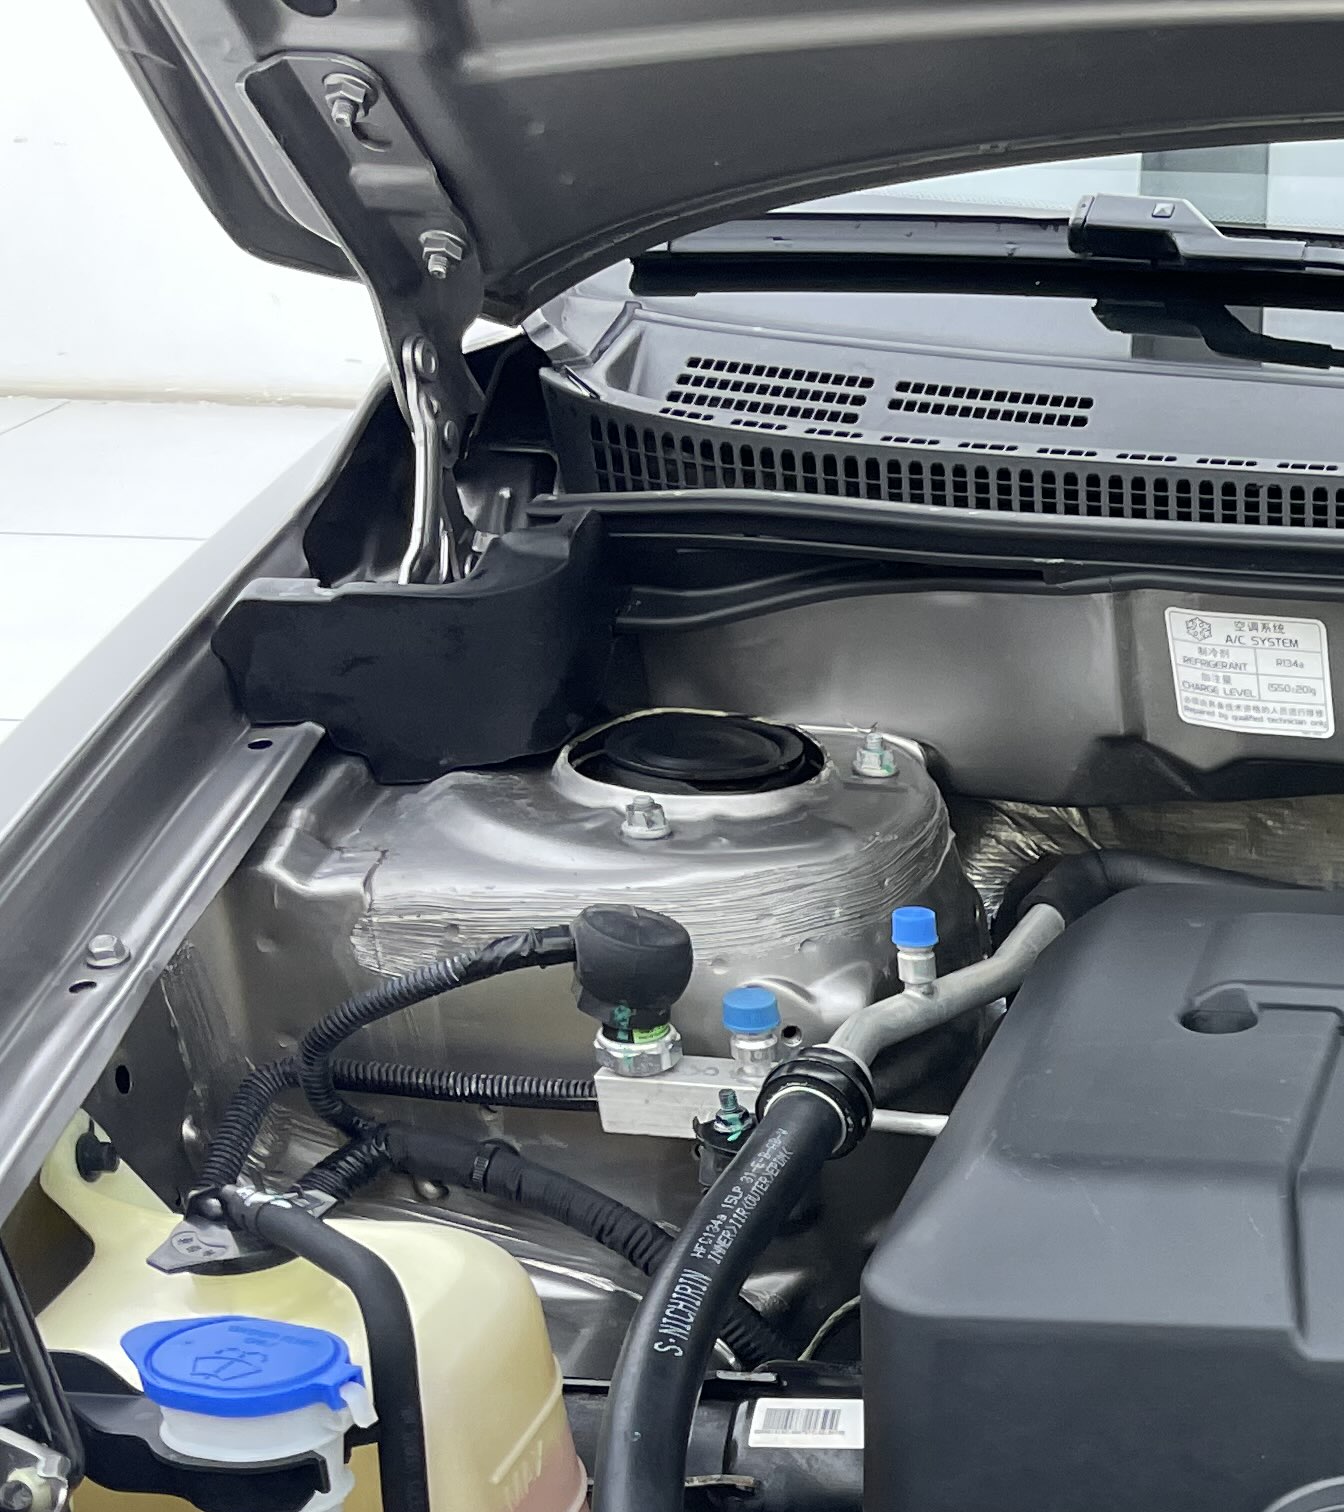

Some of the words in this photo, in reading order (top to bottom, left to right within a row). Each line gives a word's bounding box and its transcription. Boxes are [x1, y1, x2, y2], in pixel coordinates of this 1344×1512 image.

[1225, 634, 1246, 646] A/C
[1250, 636, 1299, 648] SYSTEM
[1182, 655, 1249, 671] REFRIGERANT
[1275, 658, 1304, 669] R134a
[1223, 687, 1257, 698] LEVEL
